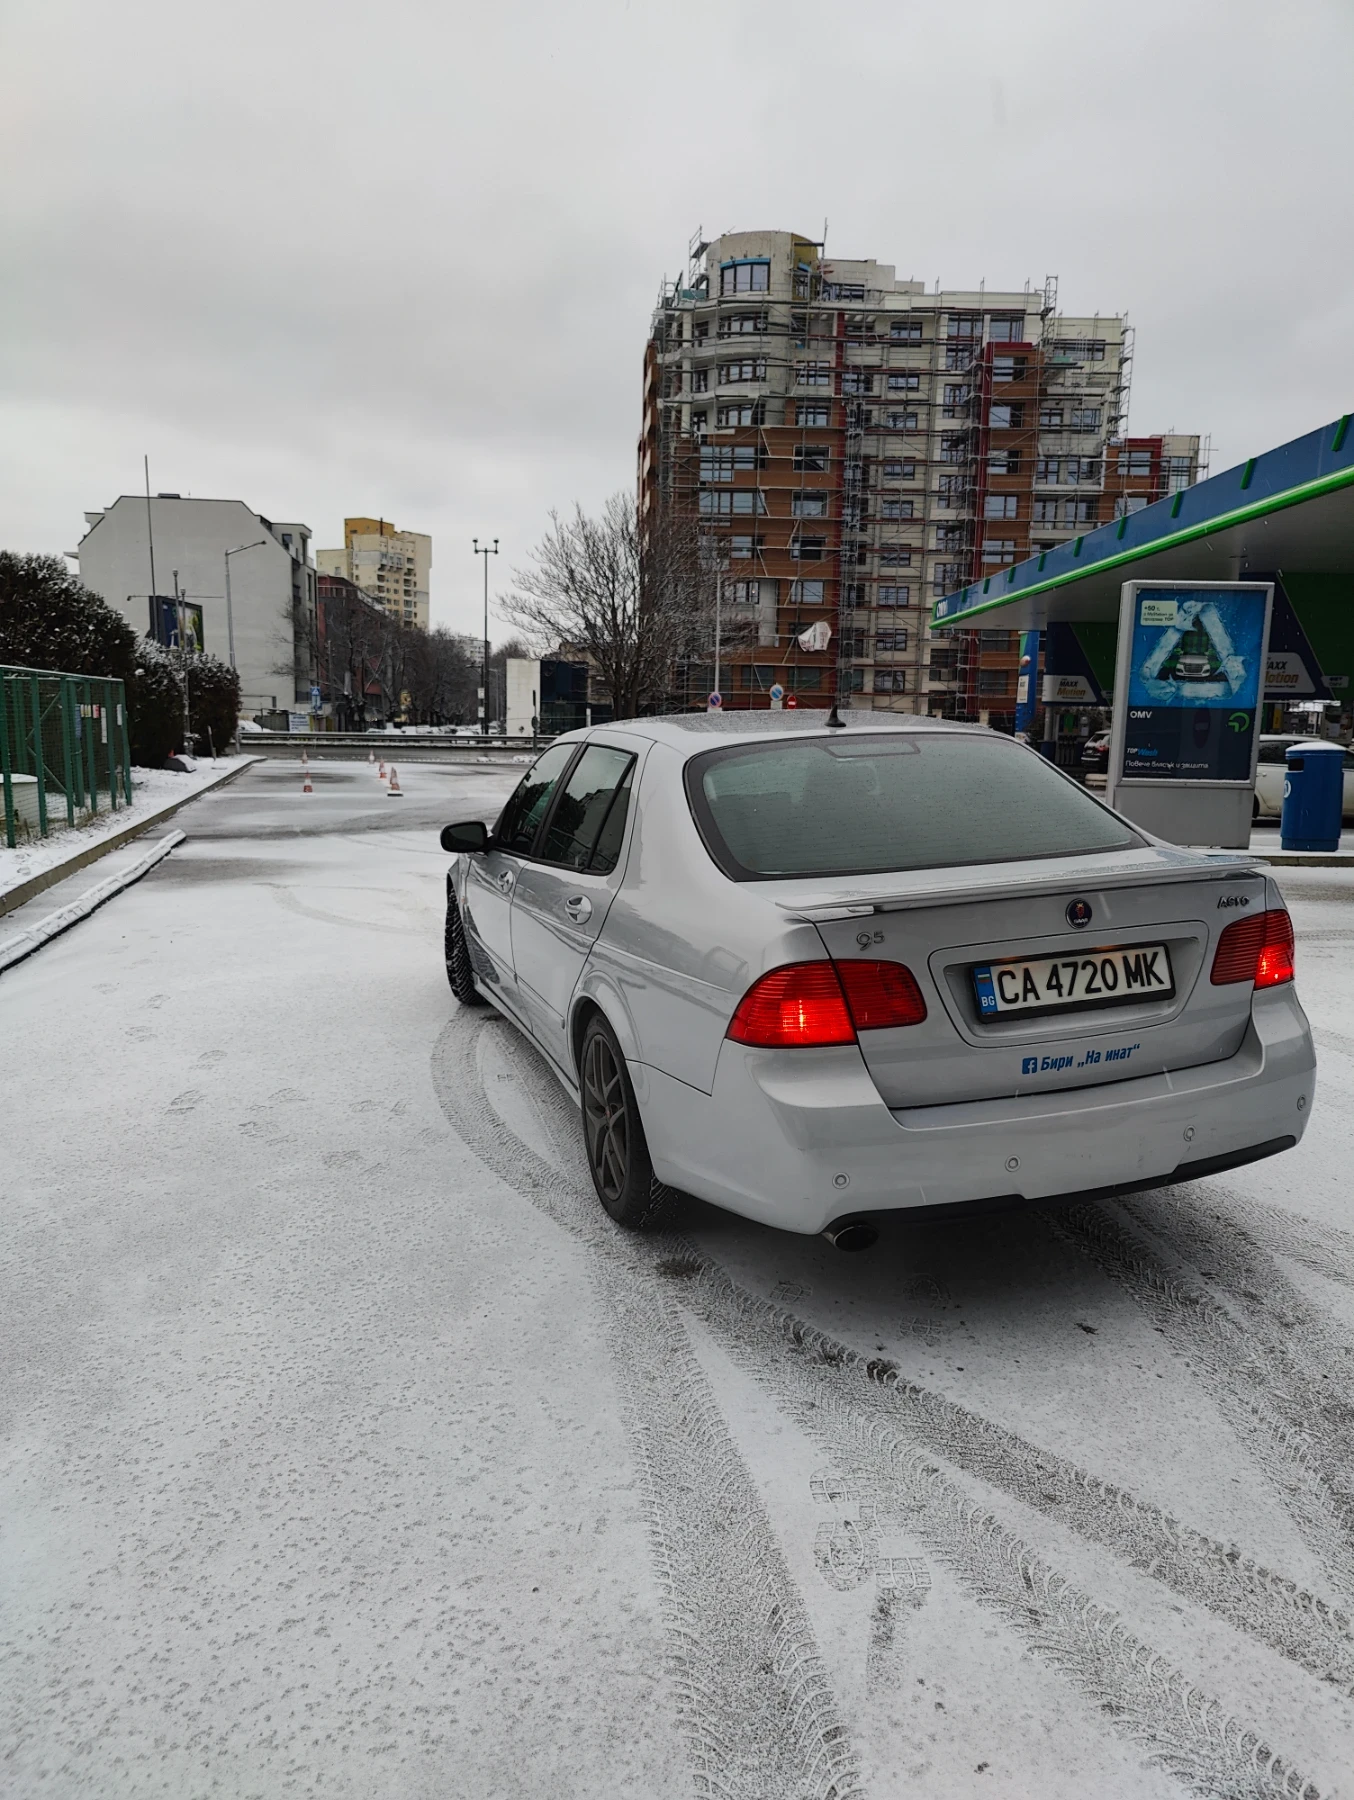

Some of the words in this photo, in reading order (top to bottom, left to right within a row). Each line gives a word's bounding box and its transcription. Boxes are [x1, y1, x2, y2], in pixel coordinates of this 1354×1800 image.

[1057, 687, 1087, 696] Motion
[1129, 710, 1153, 719] OMV
[996, 967, 1041, 1004] CA
[1046, 957, 1119, 998] 4720
[1123, 951, 1165, 989] MK
[981, 995, 995, 1007] BG
[1040, 1055, 1073, 1072] Бири
